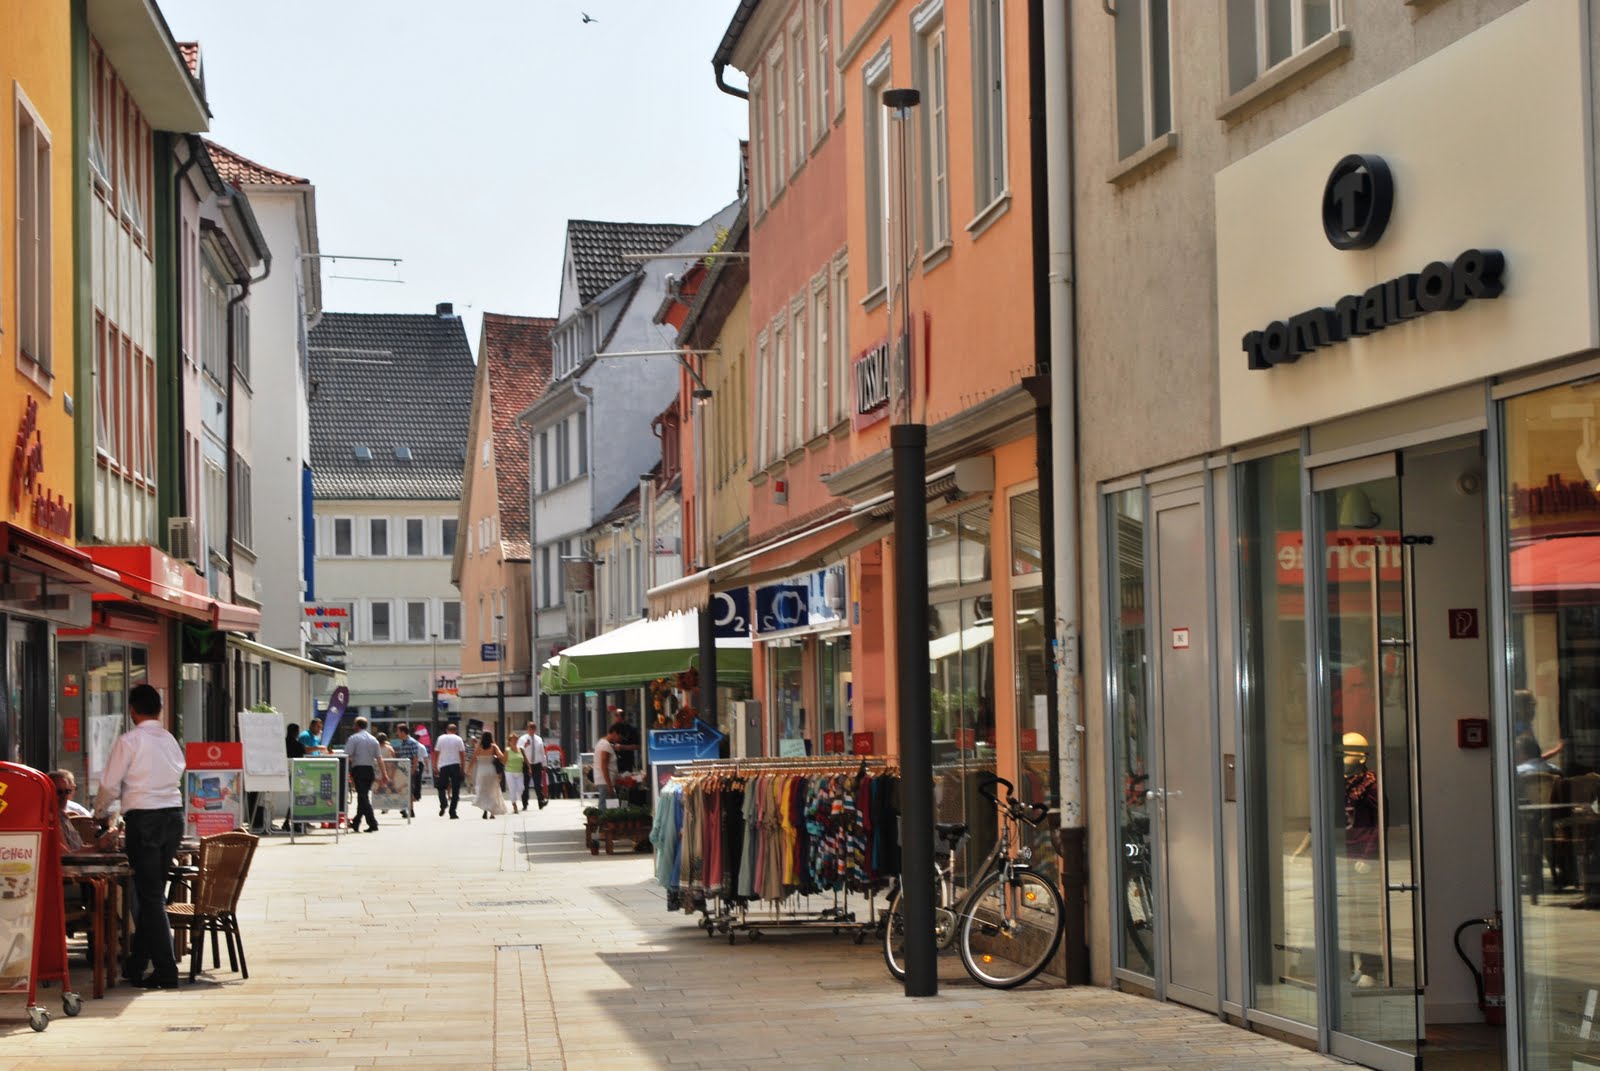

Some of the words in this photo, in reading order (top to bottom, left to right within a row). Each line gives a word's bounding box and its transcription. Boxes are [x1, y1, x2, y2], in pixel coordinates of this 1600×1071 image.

[1241, 307, 1338, 370] TOM
[1335, 248, 1506, 338] TAILOR
[437, 676, 457, 688] dm
